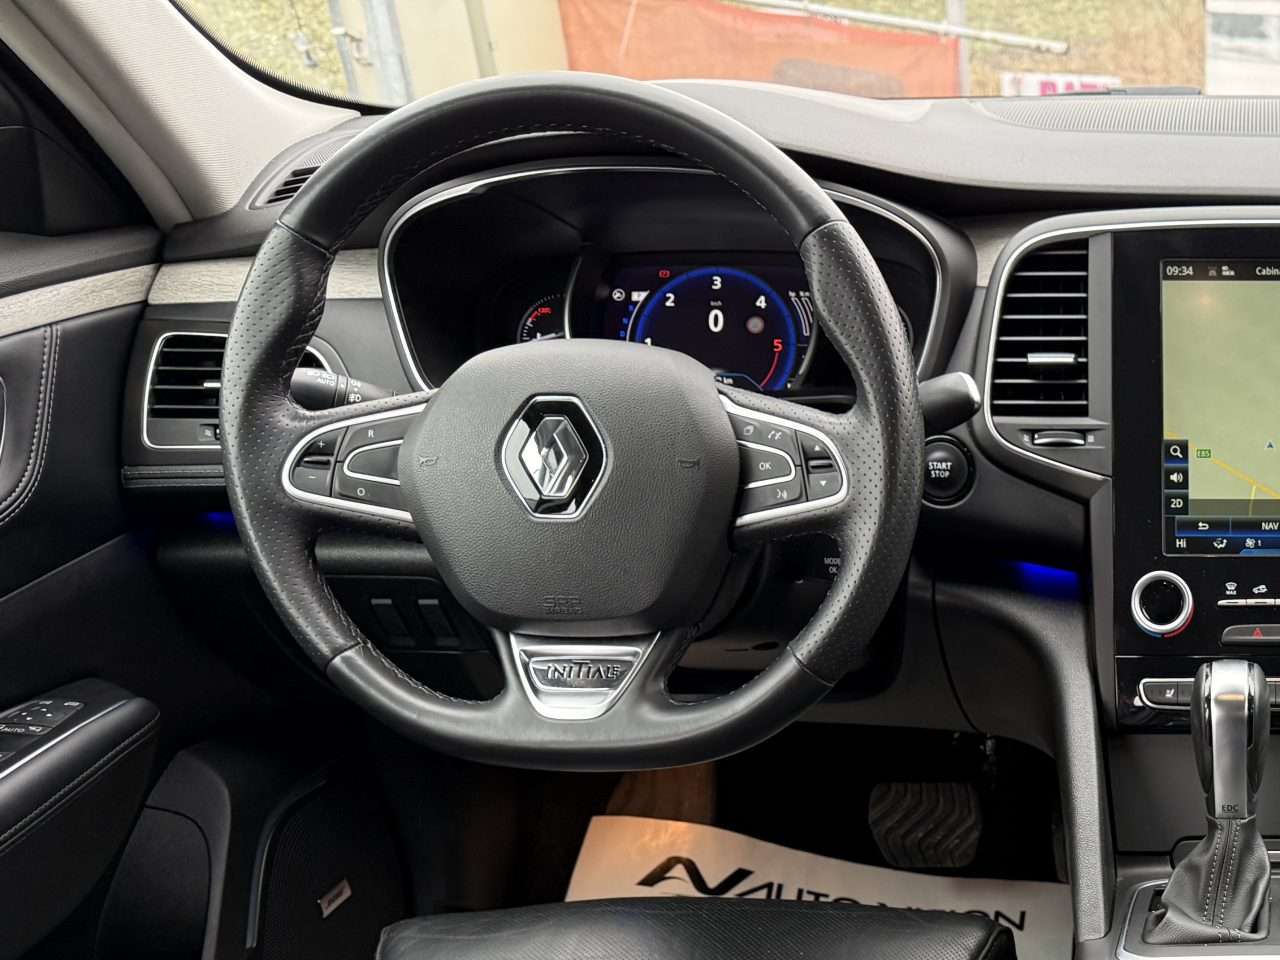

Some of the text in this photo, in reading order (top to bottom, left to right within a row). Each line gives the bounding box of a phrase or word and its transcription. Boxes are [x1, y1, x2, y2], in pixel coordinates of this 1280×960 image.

[1166, 265, 1194, 276] 09:34
[711, 276, 722, 290] 3
[665, 293, 675, 307] 2
[755, 295, 767, 309] 4
[708, 309, 724, 333] 0
[773, 339, 783, 352] 5
[367, 429, 375, 439] R
[758, 460, 772, 471] OK
[928, 461, 953, 471] START
[930, 470, 951, 479] STOP
[1170, 498, 1184, 508] 2D
[1261, 521, 1280, 531] NAV
